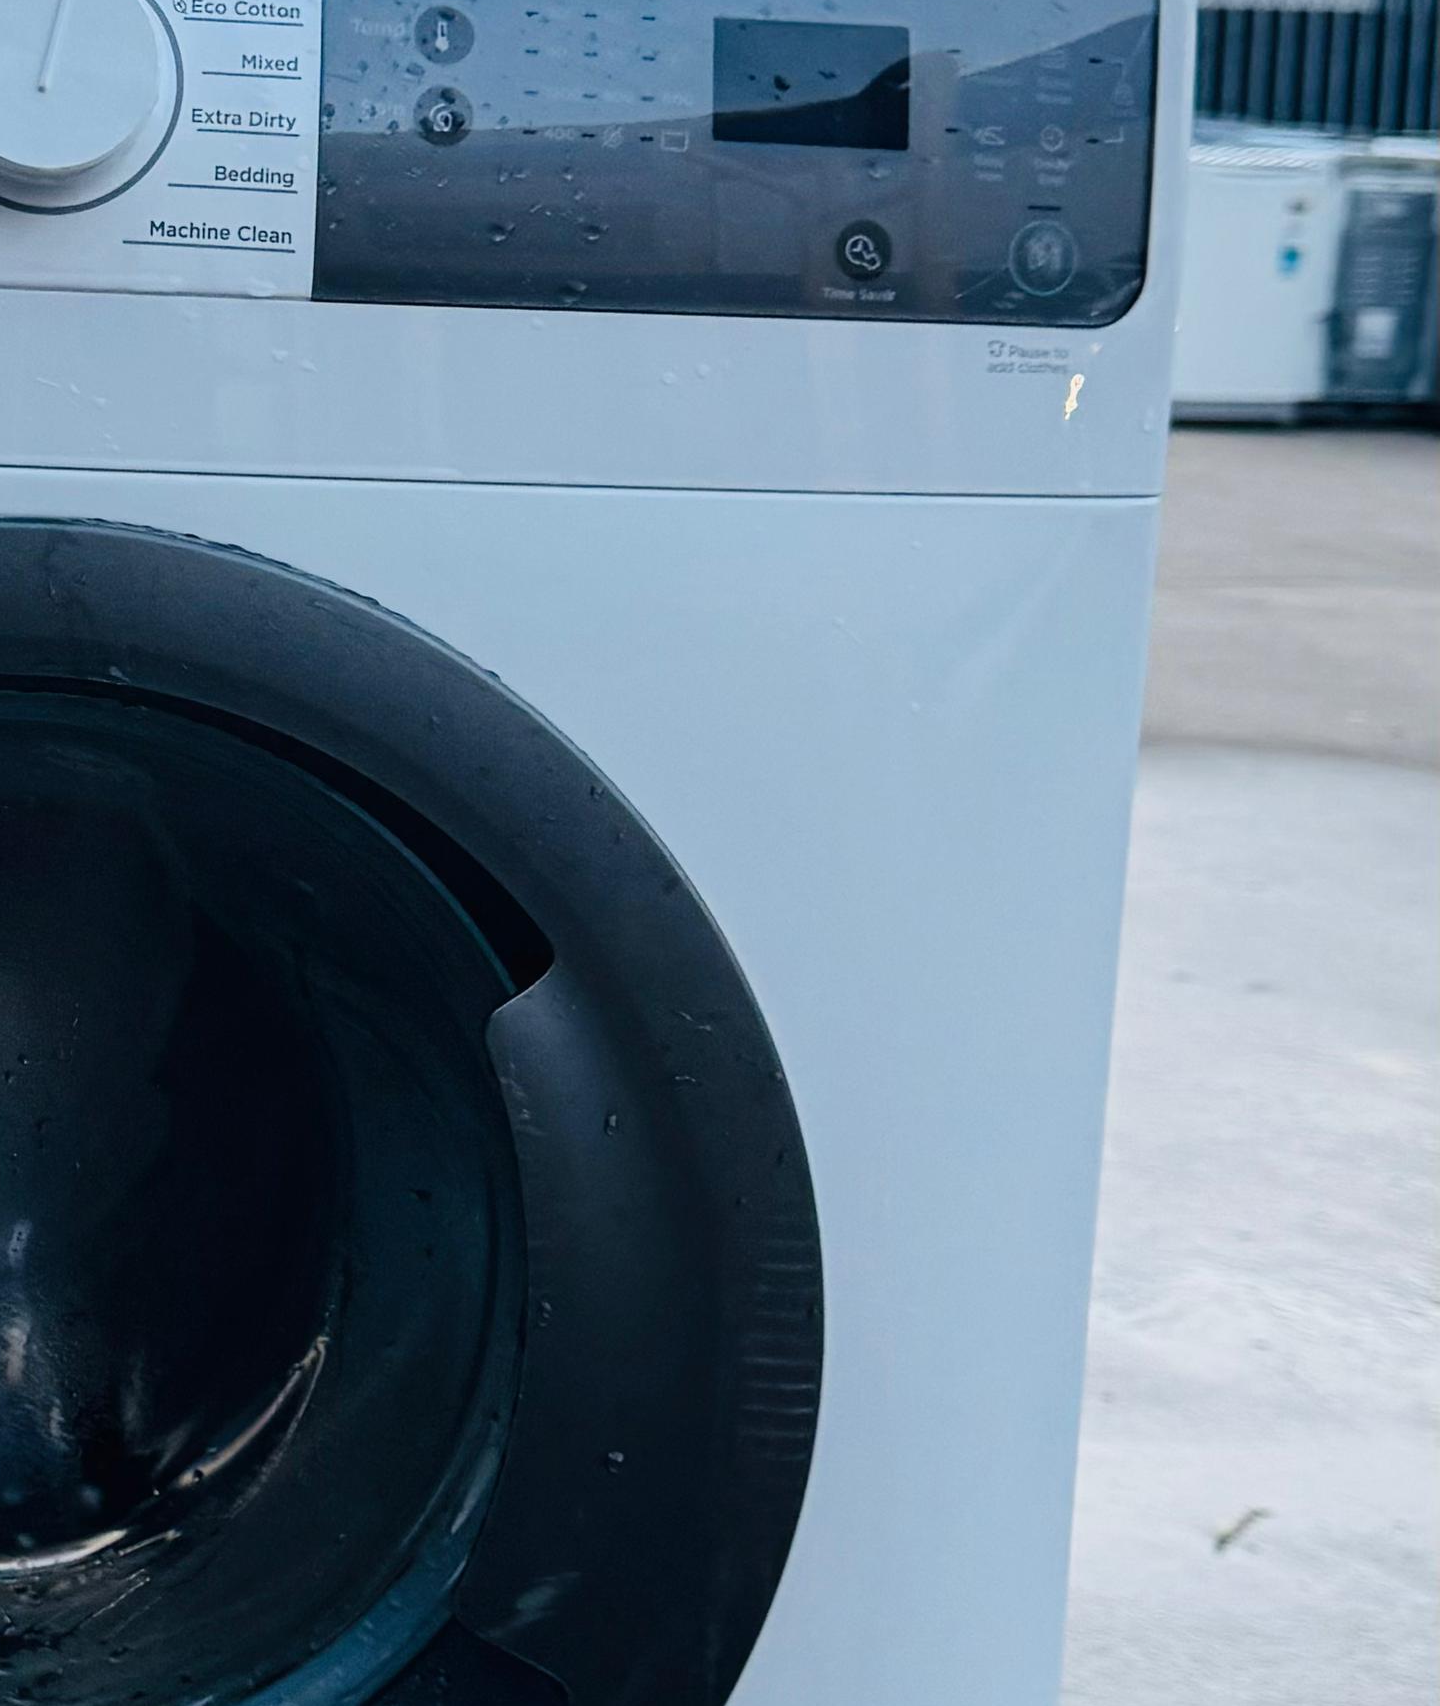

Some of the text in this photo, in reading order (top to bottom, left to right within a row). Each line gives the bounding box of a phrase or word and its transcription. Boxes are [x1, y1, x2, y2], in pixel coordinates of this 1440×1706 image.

[234, 0, 300, 19] Cotton
[241, 54, 298, 71] Mixed
[191, 108, 296, 131] Extra Dirty
[215, 165, 294, 188] Bedding
[150, 220, 292, 244] Machine Clean
